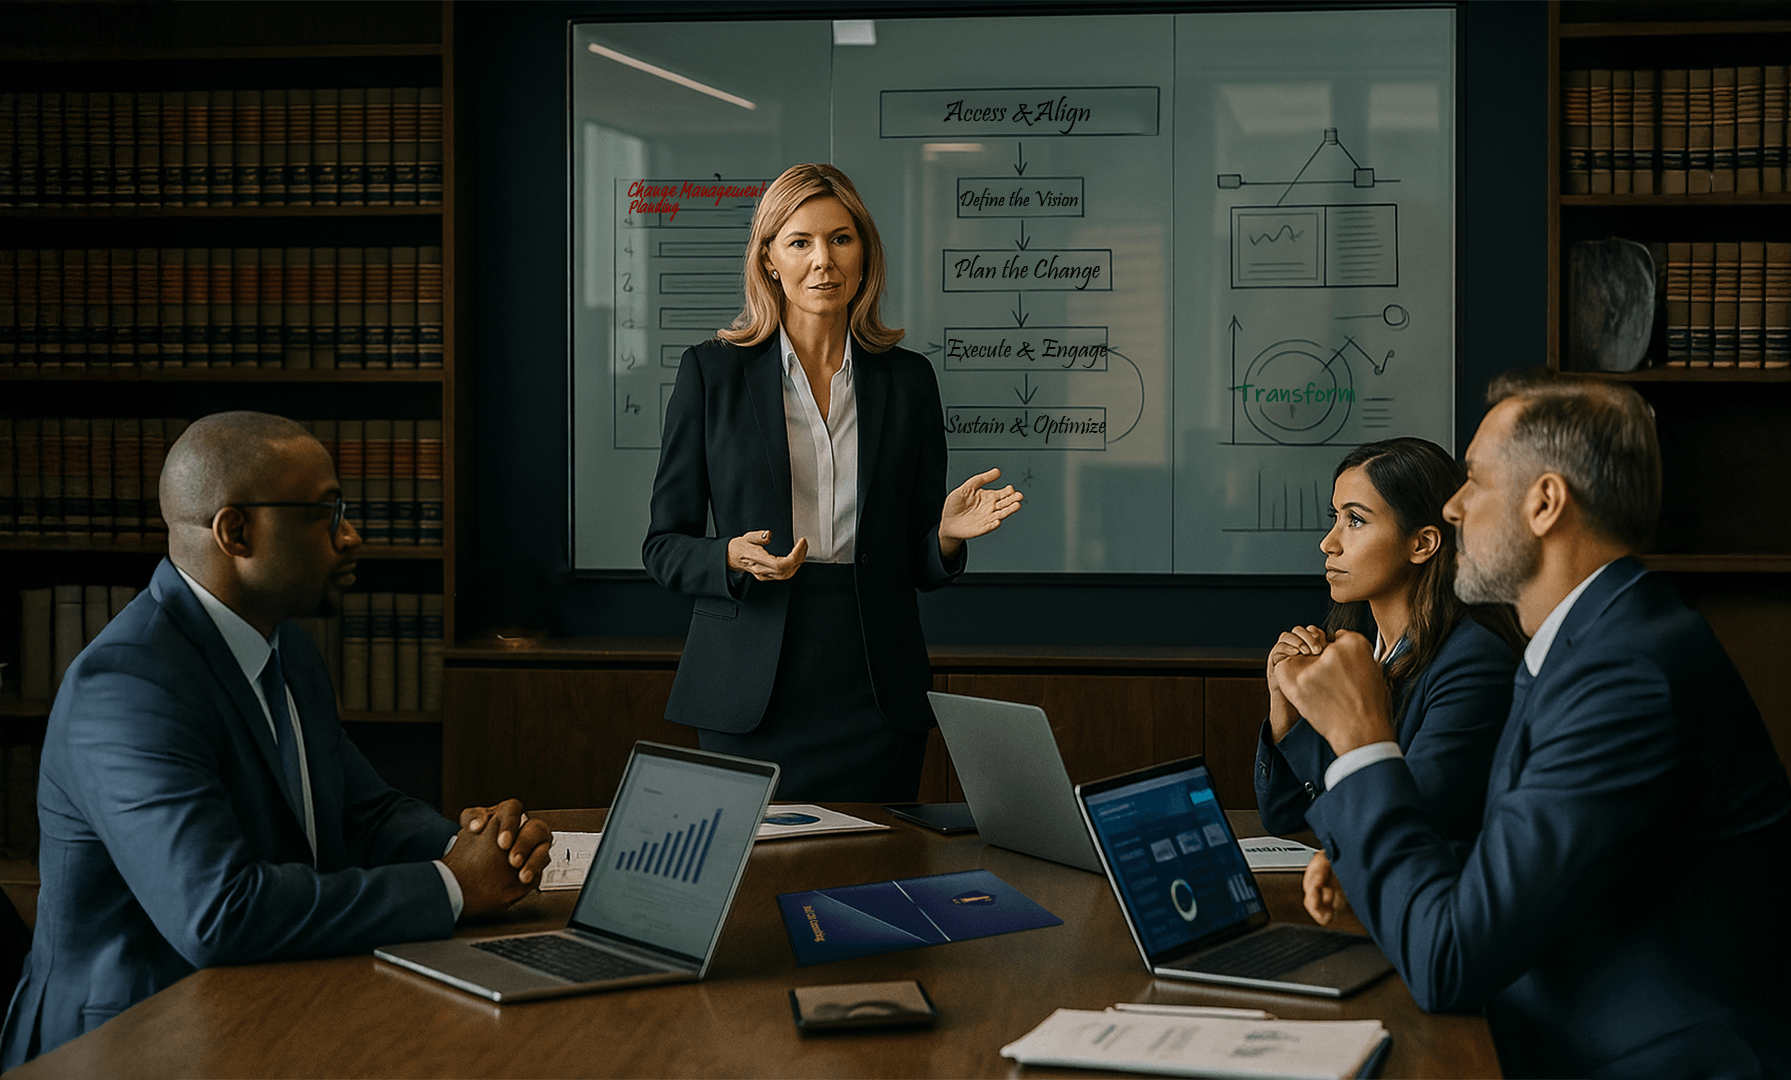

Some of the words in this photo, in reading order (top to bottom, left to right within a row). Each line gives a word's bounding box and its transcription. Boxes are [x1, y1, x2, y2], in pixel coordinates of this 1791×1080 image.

[943, 99, 1007, 123] Access
[627, 178, 678, 203] Change
[679, 180, 768, 207] Management
[959, 187, 1005, 212] Define
[1008, 187, 1030, 207] the
[1035, 189, 1079, 208] Vision
[954, 254, 997, 279] Plan
[1001, 254, 1029, 279] the
[1033, 254, 1101, 291] Change
[946, 338, 1012, 362] Execute
[1016, 341, 1036, 362] &
[1041, 338, 1108, 369] Engage
[1235, 381, 1356, 405] Transform
[944, 414, 1005, 434] Sustain
[1009, 417, 1028, 438] &
[1033, 414, 1107, 445] Optimize
